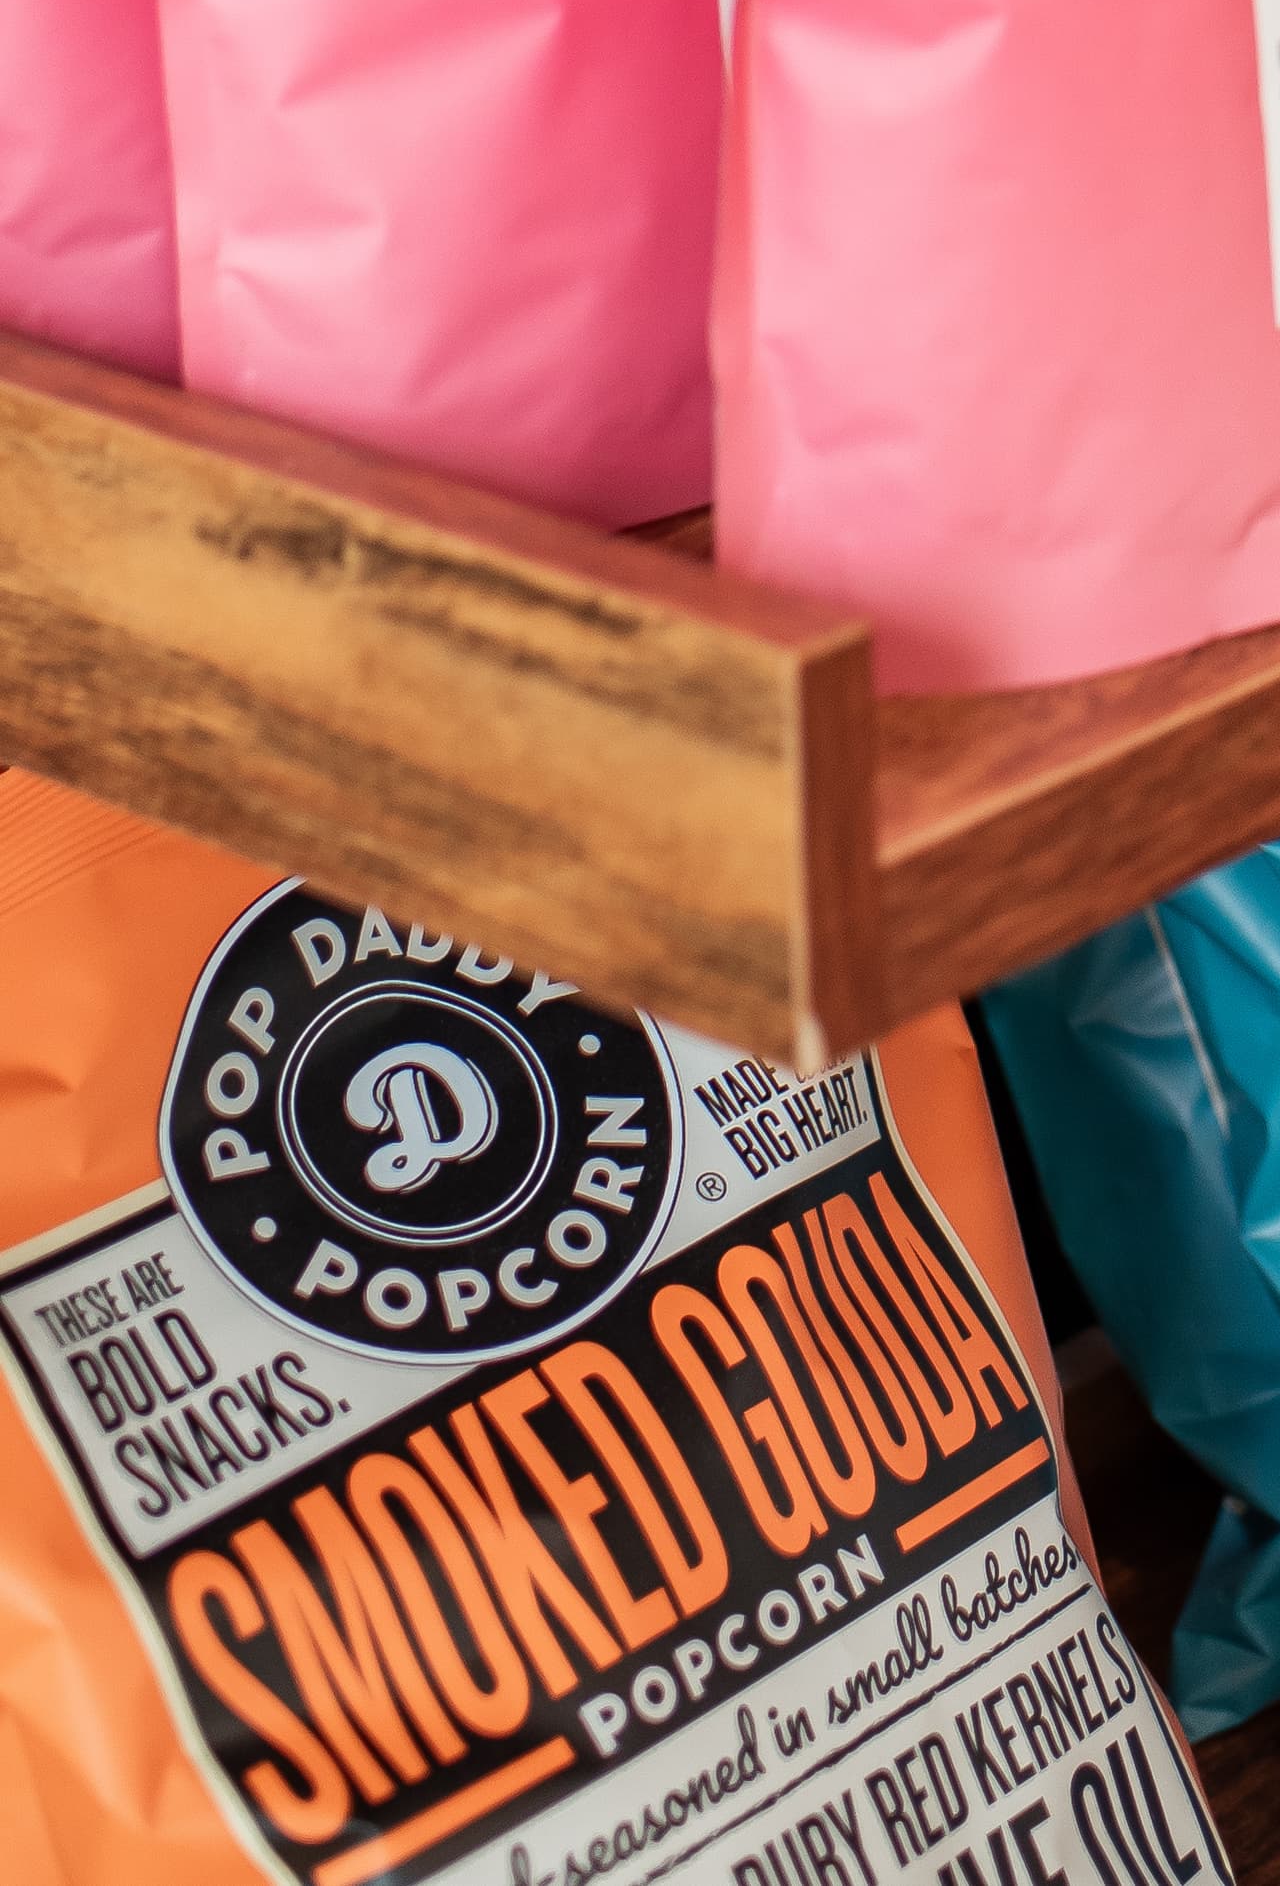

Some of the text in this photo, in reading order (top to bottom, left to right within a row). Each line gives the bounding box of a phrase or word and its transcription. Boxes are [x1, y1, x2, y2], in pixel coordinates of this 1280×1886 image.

[202, 986, 278, 1181] POP
[693, 1055, 790, 1127] MADE
[723, 1108, 800, 1181] BIG
[781, 1066, 868, 1152] HEART.
[293, 1094, 648, 1332] POPCORN
[35, 1251, 185, 1350] THESE ARE
[67, 1307, 218, 1435] BOLD
[114, 1350, 352, 1520] SNACKS.
[164, 1340, 732, 1846] SMOKED
[649, 1170, 1030, 1546] GOUDA
[577, 1533, 887, 1757] POPCORN
[767, 1705, 817, 1757] in
[826, 1594, 945, 1728] small
[860, 1731, 971, 1869] RED
[954, 1610, 1137, 1807] KERNELS
[1069, 1725, 1203, 1886] OIL
